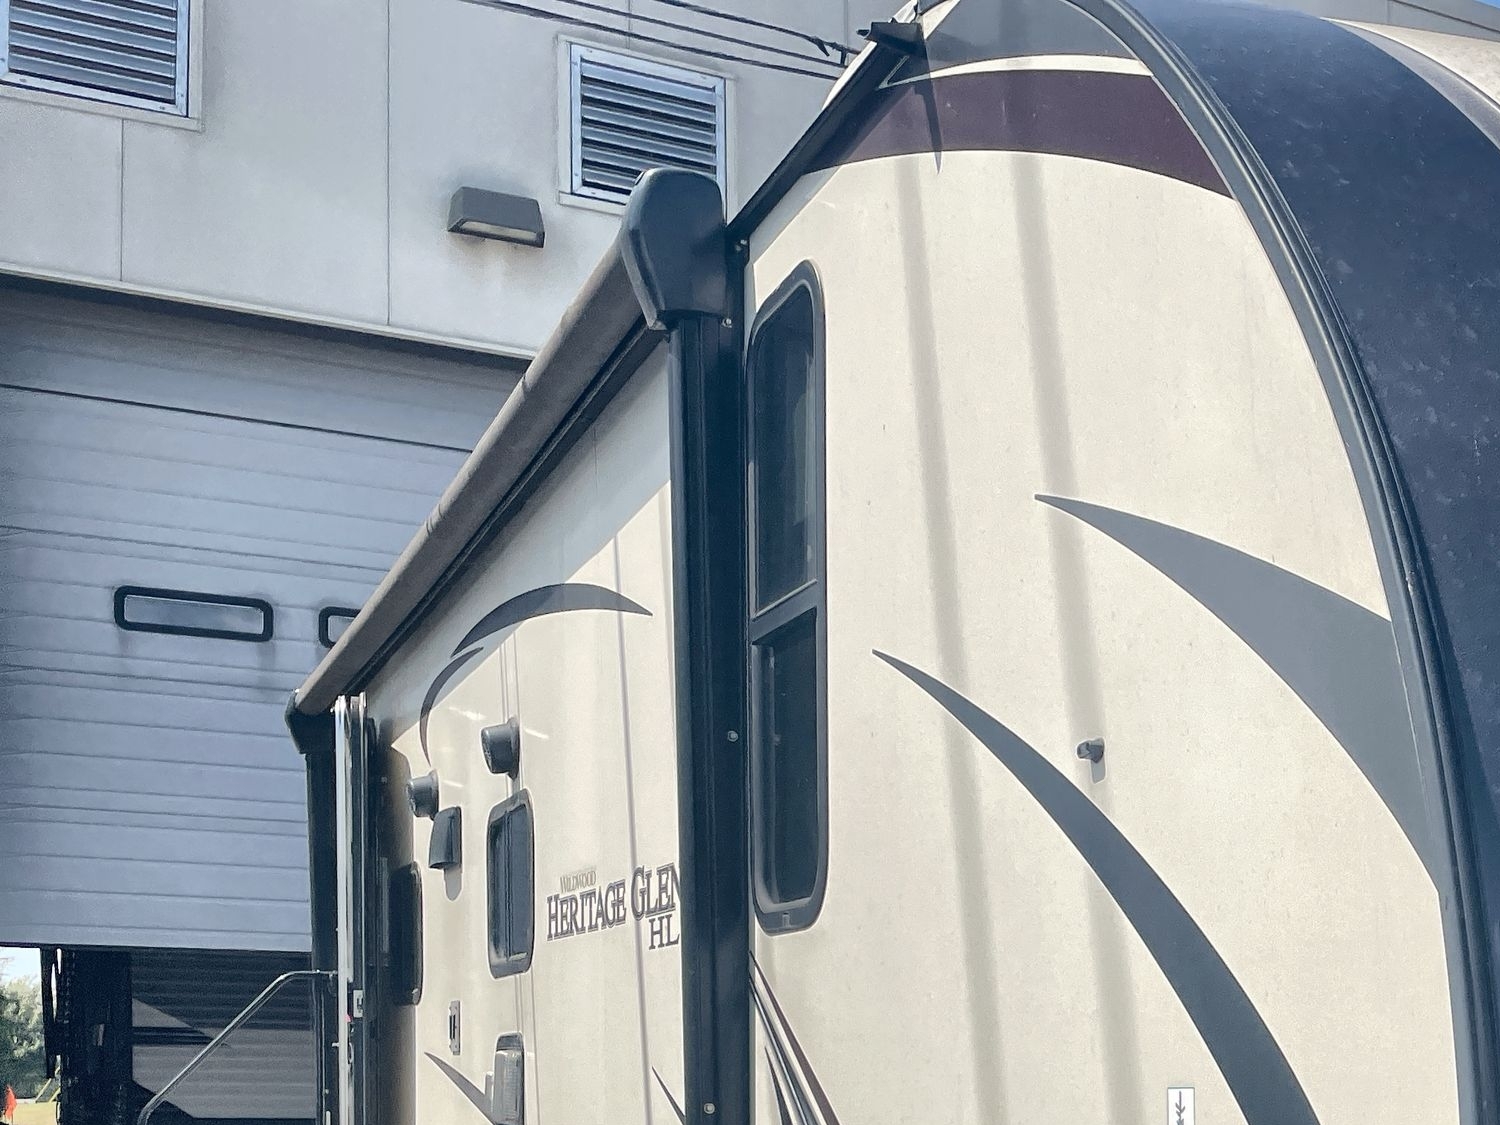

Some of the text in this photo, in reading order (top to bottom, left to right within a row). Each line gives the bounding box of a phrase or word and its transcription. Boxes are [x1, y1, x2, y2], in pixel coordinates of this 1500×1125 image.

[560, 870, 596, 894] WILDWOOD
[547, 862, 680, 942] HERITAGE GLEN
[649, 914, 680, 950] HL
